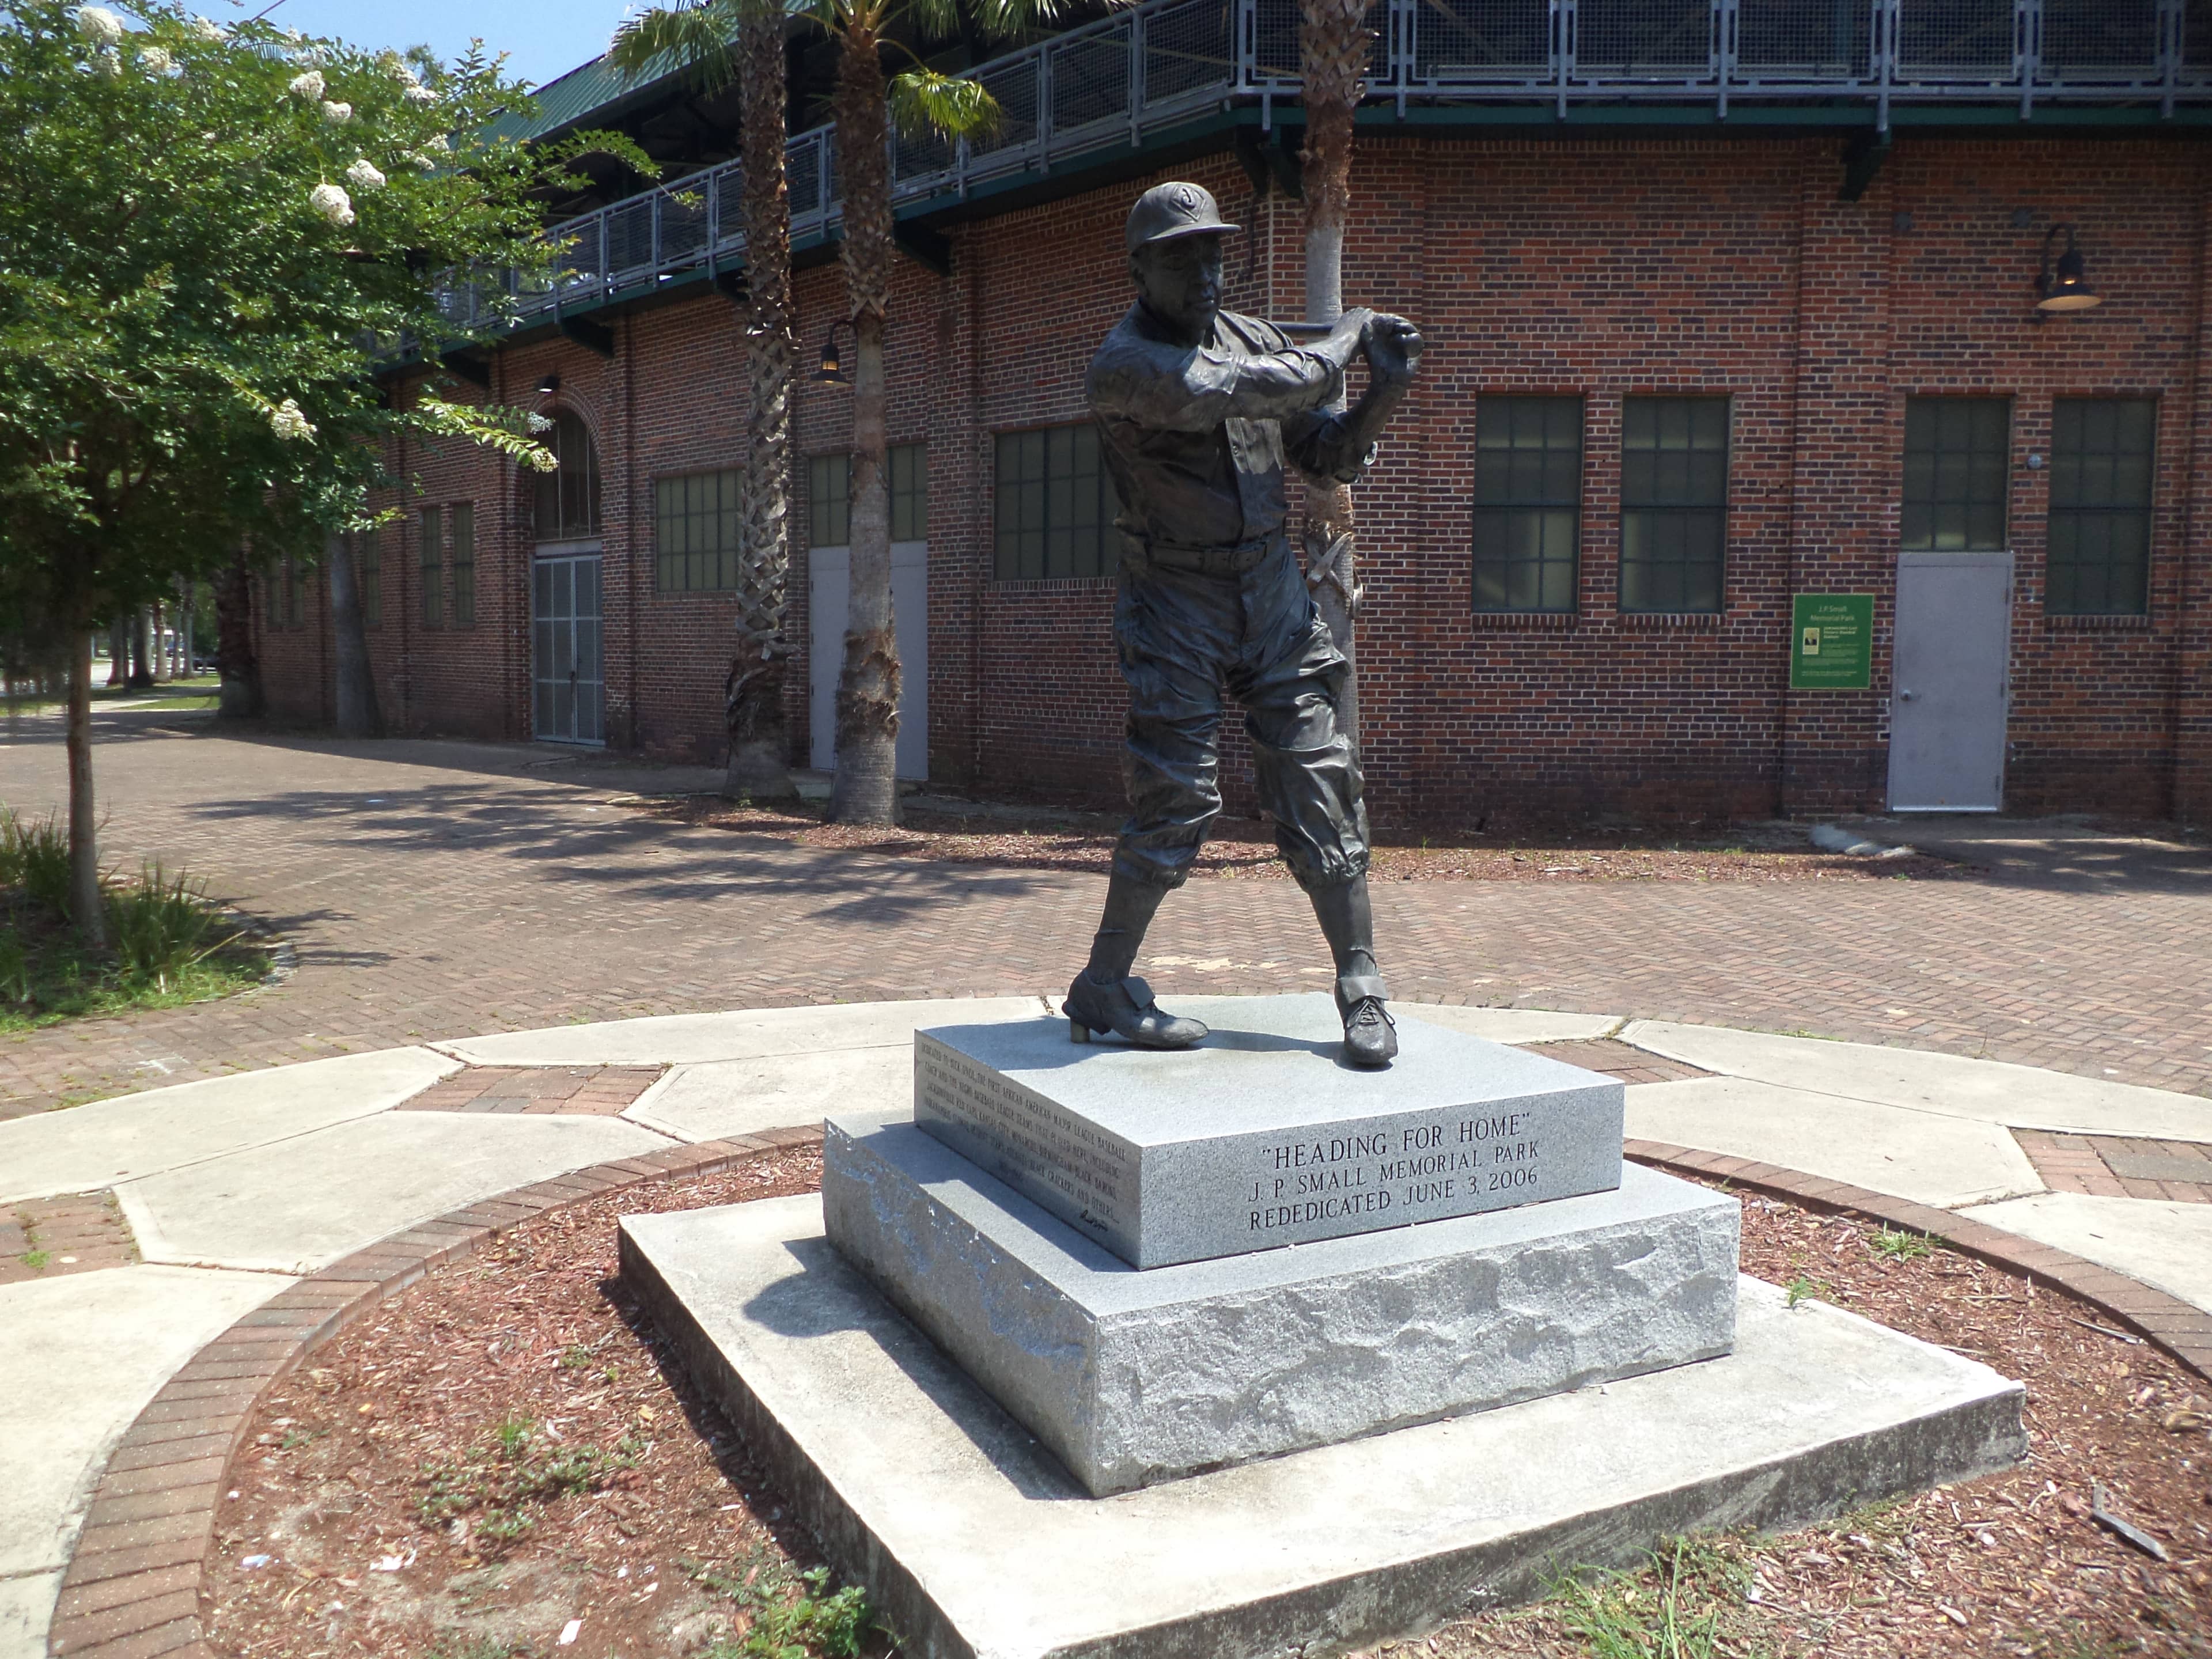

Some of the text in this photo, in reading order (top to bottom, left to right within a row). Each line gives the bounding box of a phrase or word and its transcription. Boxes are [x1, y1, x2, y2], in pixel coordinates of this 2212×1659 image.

[988, 1078, 999, 1094] FIRST
[1025, 1098, 1050, 1121] AMERICAN
[1054, 1113, 1070, 1132] MAJOR
[1074, 1124, 1094, 1145] LEAGUE
[1097, 1137, 1125, 1162] BASEBALL
[1017, 1112, 1032, 1131] TEAMS
[1262, 1112, 1530, 1169] "HEADING FOR HOME"
[1297, 1169, 1366, 1195] SMALL
[1380, 1150, 1482, 1182] MEMORIAL
[1495, 1141, 1540, 1164] PARK
[1250, 1166, 1537, 1230] REDEDICATED JUNE 3, 2006
